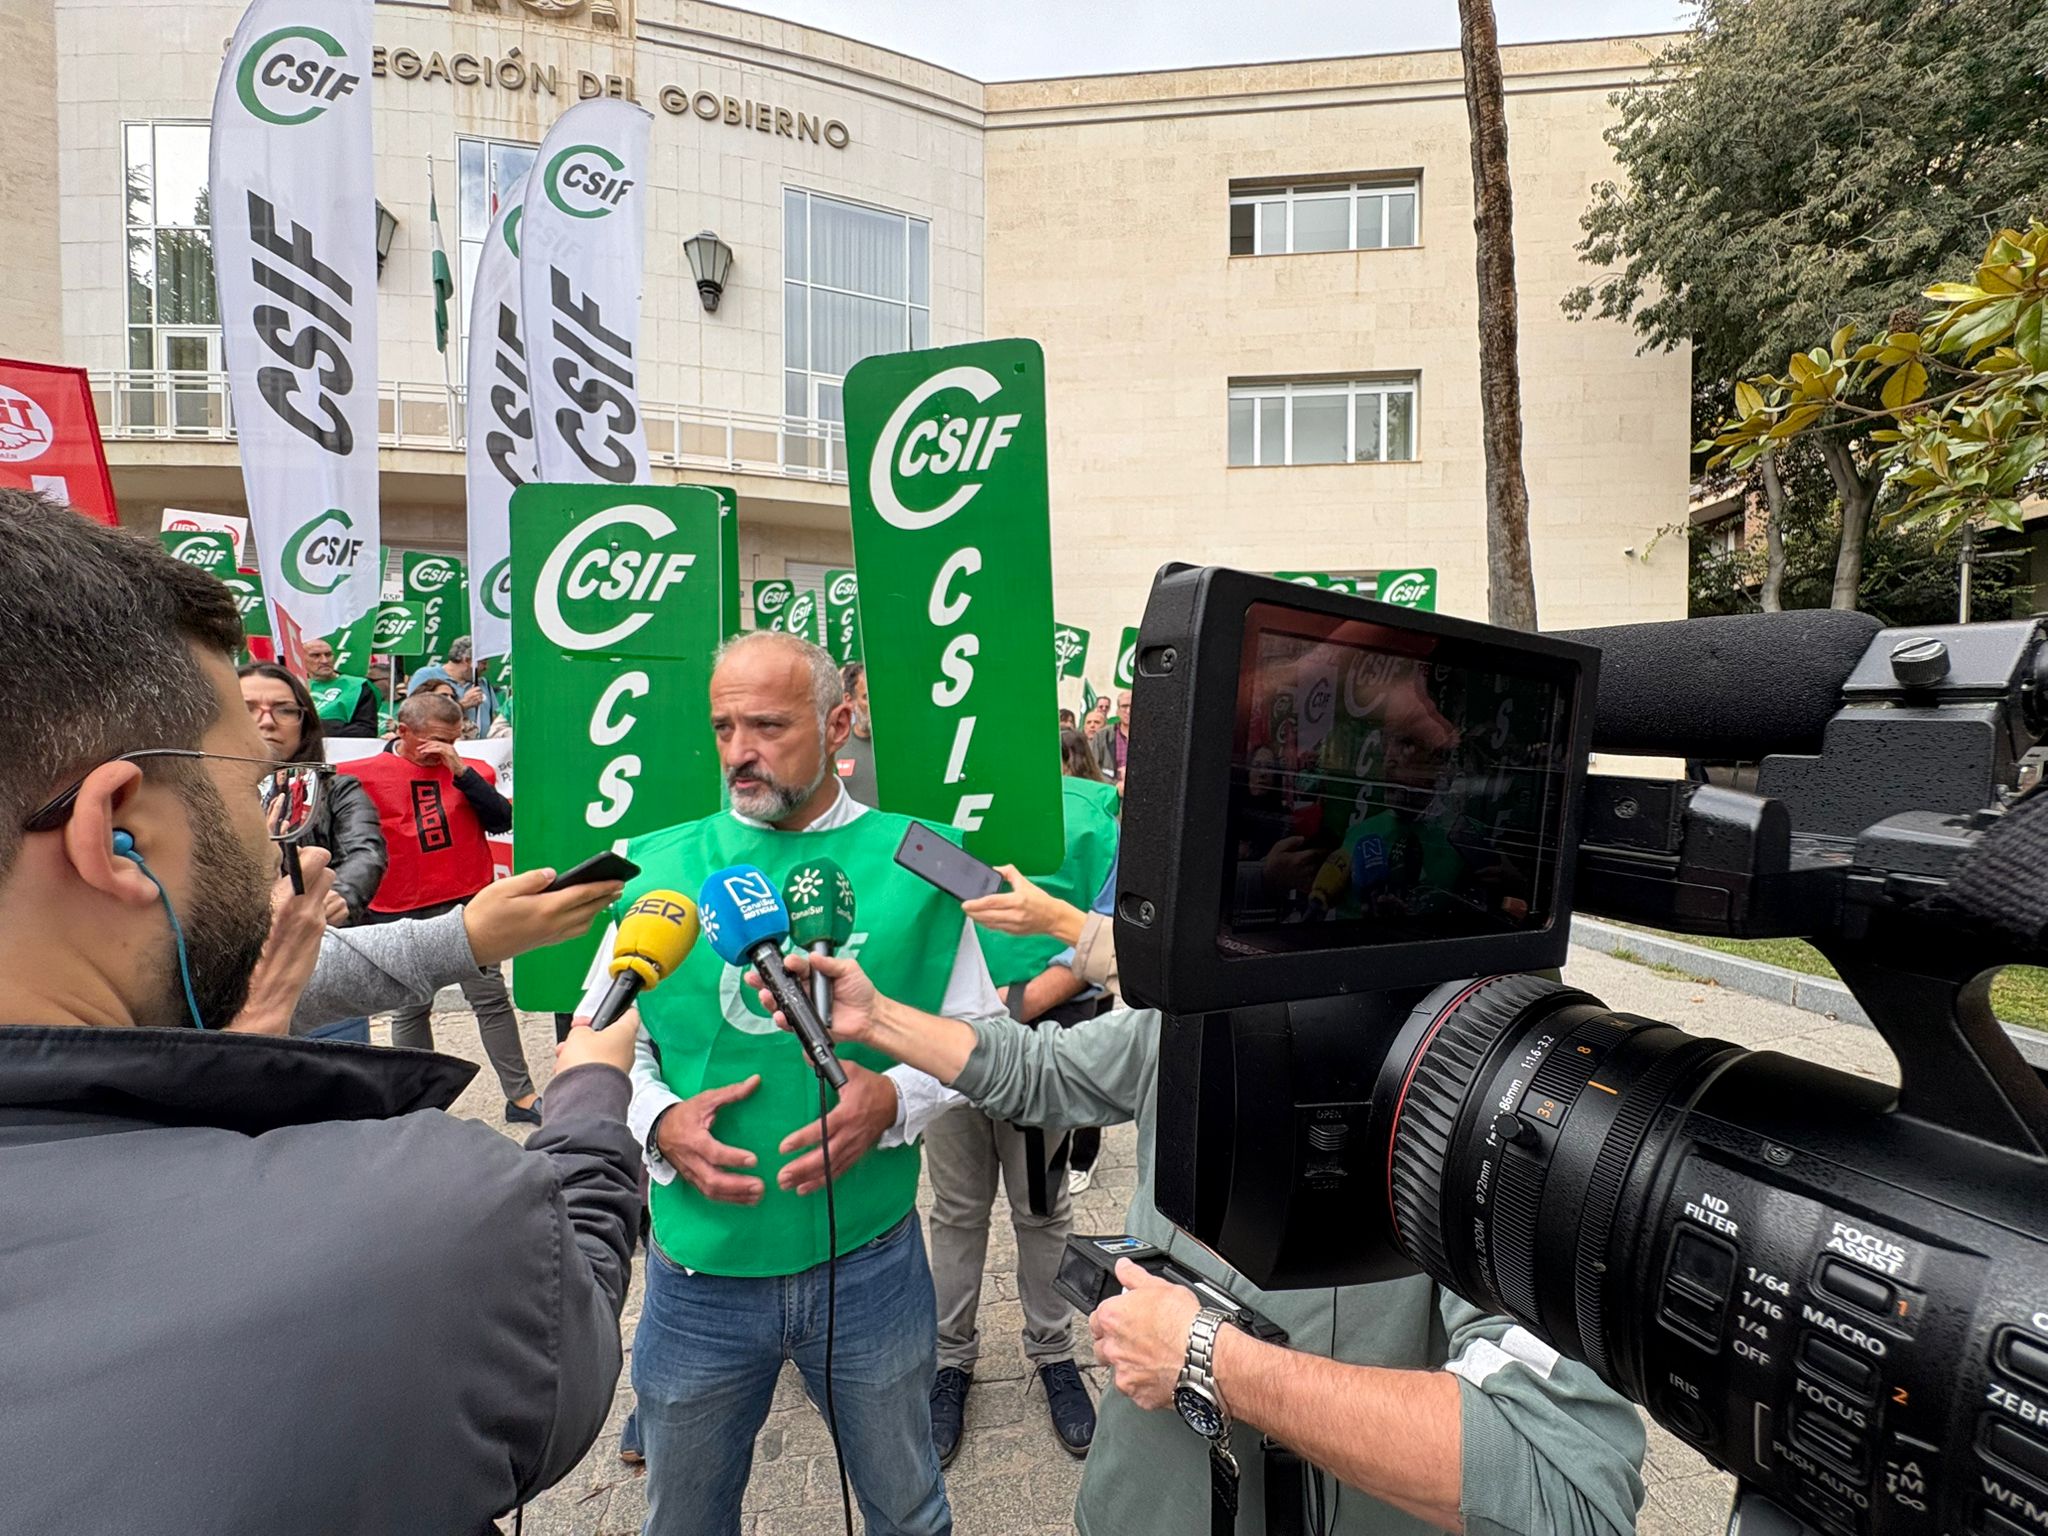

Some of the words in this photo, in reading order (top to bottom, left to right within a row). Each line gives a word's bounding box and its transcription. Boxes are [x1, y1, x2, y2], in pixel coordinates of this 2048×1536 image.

[261, 52, 360, 103] CSIF
[371, 46, 557, 97] EGACIÓN
[658, 84, 850, 149] GOBIERNO
[562, 163, 635, 205] CSIF
[247, 188, 354, 456] CSIF
[550, 264, 637, 484] CSIF
[899, 413, 1022, 478] CSIF
[181, 549, 226, 565] CSIF
[305, 536, 363, 567] CSIF
[418, 567, 455, 583] CSIF
[566, 550, 696, 601] CSIF
[836, 581, 858, 595] CSI
[765, 591, 790, 604] CSIF
[1391, 584, 1430, 602] CSIF
[793, 602, 813, 622] CSIF
[374, 619, 416, 635] CSIF
[841, 608, 855, 660] CSI
[584, 671, 650, 829] CS
[625, 898, 686, 926] SER
[743, 905, 780, 921] NOTICIAS
[1576, 1045, 1592, 1055] 8
[1536, 1099, 1555, 1119] 3.9
[1474, 1217, 1487, 1255] ZOOM
[1520, 1034, 1555, 1071] 1:1.6-3.2
[1701, 1192, 1730, 1215] ND
[1684, 1202, 1738, 1237] FILTER
[1826, 1237, 1904, 1275] ASSIST
[1832, 1221, 1905, 1263] FOCUS
[1747, 1266, 1791, 1297] 1/64
[1742, 1290, 1784, 1320] 1/16
[1897, 1300, 1909, 1317] 1
[1737, 1315, 1769, 1340] 1/4
[1801, 1304, 1887, 1357] MACRO
[1732, 1339, 1772, 1366] OFF
[1669, 1372, 1701, 1400] IRIS
[1892, 1386, 1910, 1406] 2
[1795, 1378, 1867, 1430] FOCUS
[1772, 1439, 1816, 1477] PUSH
[1817, 1470, 1869, 1509] AUTO
[1899, 1474, 1926, 1494] M
[1903, 1461, 1924, 1478] A
